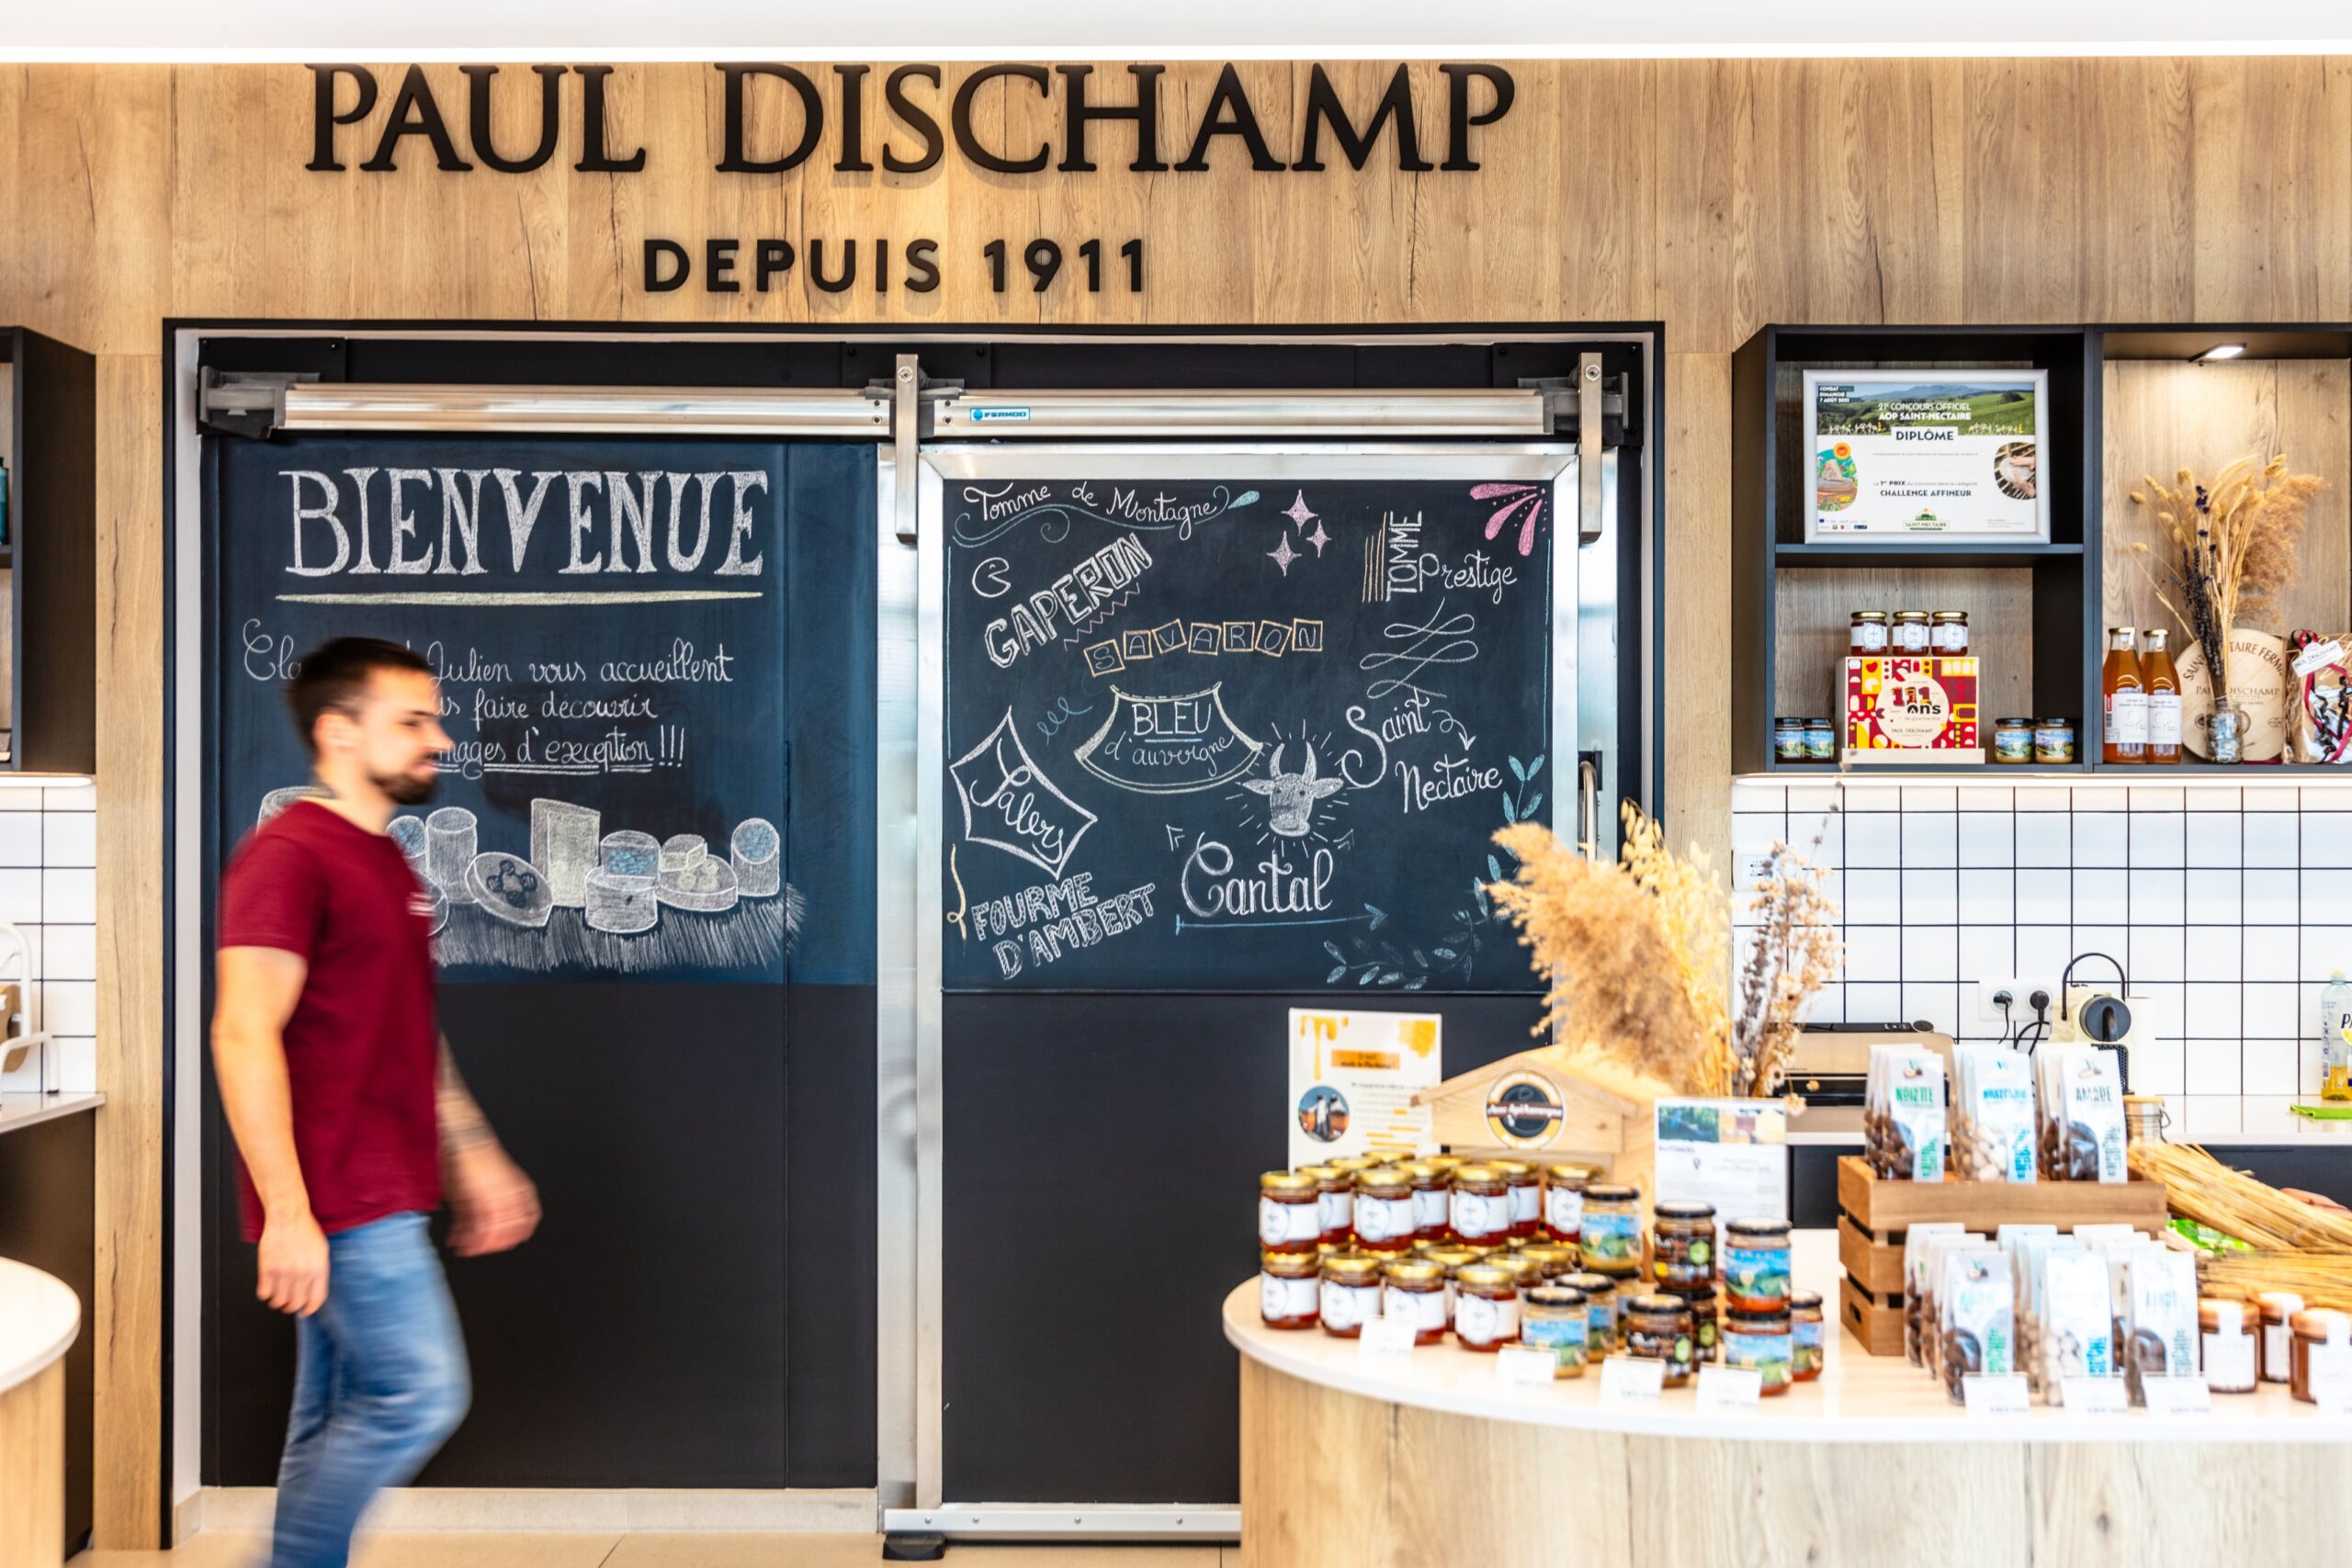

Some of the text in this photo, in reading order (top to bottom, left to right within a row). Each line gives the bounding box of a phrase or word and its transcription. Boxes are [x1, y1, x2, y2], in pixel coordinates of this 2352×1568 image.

[304, 62, 1515, 174] PAUL DISCHAMP
[644, 239, 1142, 293] DEPUIS 1911
[1890, 402, 1933, 411] CONCOURS
[1936, 402, 1971, 411] OFFICIEL
[1895, 428, 1954, 441] DIPLÔME
[278, 467, 769, 577] BIENVENUE
[964, 480, 1217, 541] Tomme de Montagne
[1385, 510, 1423, 603] TOMME
[1419, 548, 1518, 604] Prestige
[984, 532, 1153, 669] GAPERON
[529, 660, 587, 683] vous
[600, 637, 735, 683] accueillent
[1084, 618, 1324, 678] SAVARON
[471, 688, 530, 732] faire
[541, 690, 660, 719] découvrir
[1132, 701, 1212, 735] BLEU
[1335, 686, 1431, 789] Saint
[1906, 704, 1941, 715] ans
[1395, 753, 1504, 814] Nectaire
[1181, 830, 1333, 919] Cantal
[971, 871, 1099, 942] FOURME
[992, 882, 1156, 980] D'AMBERT
